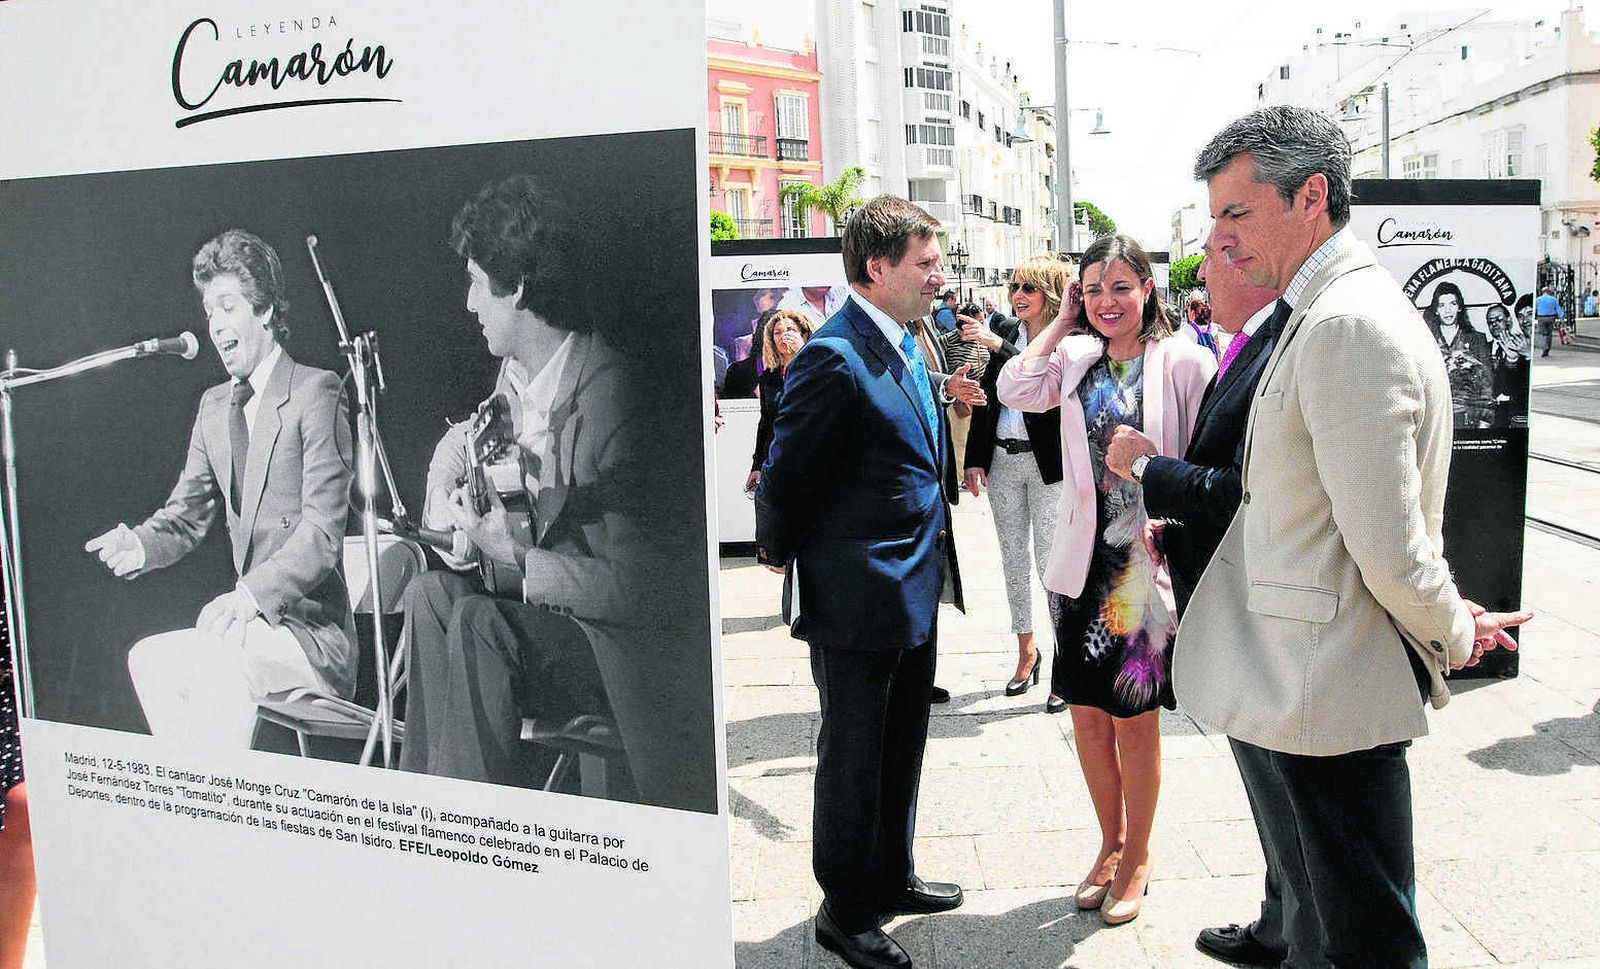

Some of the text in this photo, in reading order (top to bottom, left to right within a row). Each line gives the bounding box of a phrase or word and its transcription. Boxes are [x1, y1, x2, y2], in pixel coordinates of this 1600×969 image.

[172, 18, 393, 111] Camarón
[236, 15, 338, 39] LEYENDA
[1377, 217, 1453, 244] Camarón
[1417, 258, 1471, 281] FLAMENCA
[1471, 259, 1513, 299] GADITANA
[64, 752, 625, 850] Madrid, 12-5-1983. El cantaor José Monge Cruz "Camarón de la Isla" (i), acompañado a la guitarra por
[66, 769, 88, 783] José
[91, 772, 141, 791] Fernández
[143, 780, 174, 796] Torres
[233, 795, 272, 812] durante
[275, 803, 288, 814] su
[291, 806, 343, 824] actuación
[347, 815, 361, 826] en
[364, 816, 374, 828] el
[377, 816, 417, 835] festival
[421, 824, 476, 845] flamenco
[479, 835, 540, 855] celebrado
[544, 847, 560, 858] en
[564, 848, 575, 861] el
[579, 849, 628, 869] Palacio
[632, 858, 649, 872] de
[68, 784, 539, 874] Deportes, dentro de la programación de las fiestas de San Isidro. EFE/Leopoldo Gómez
